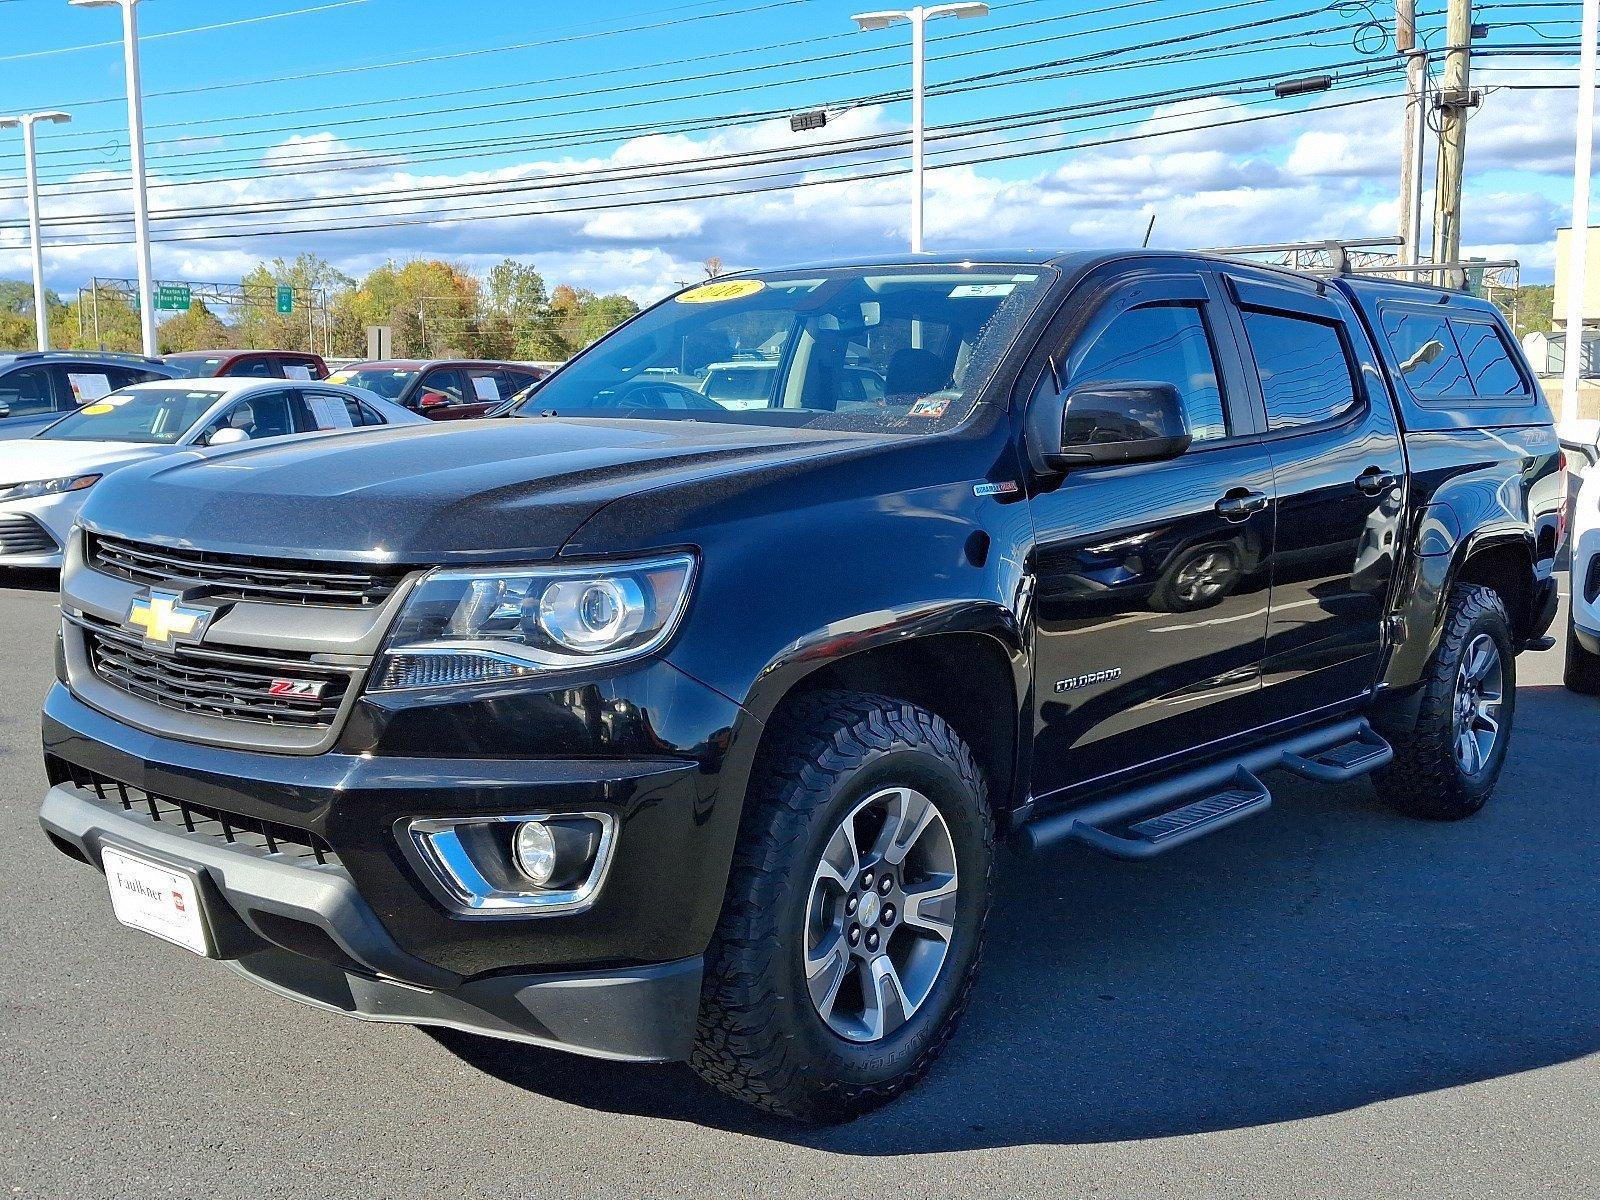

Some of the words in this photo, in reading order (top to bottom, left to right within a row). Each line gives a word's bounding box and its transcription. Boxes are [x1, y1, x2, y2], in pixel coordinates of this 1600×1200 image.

[268, 679, 327, 699] Z71
[1055, 667, 1122, 693] COLORADO
[117, 872, 162, 902] Faulkner
